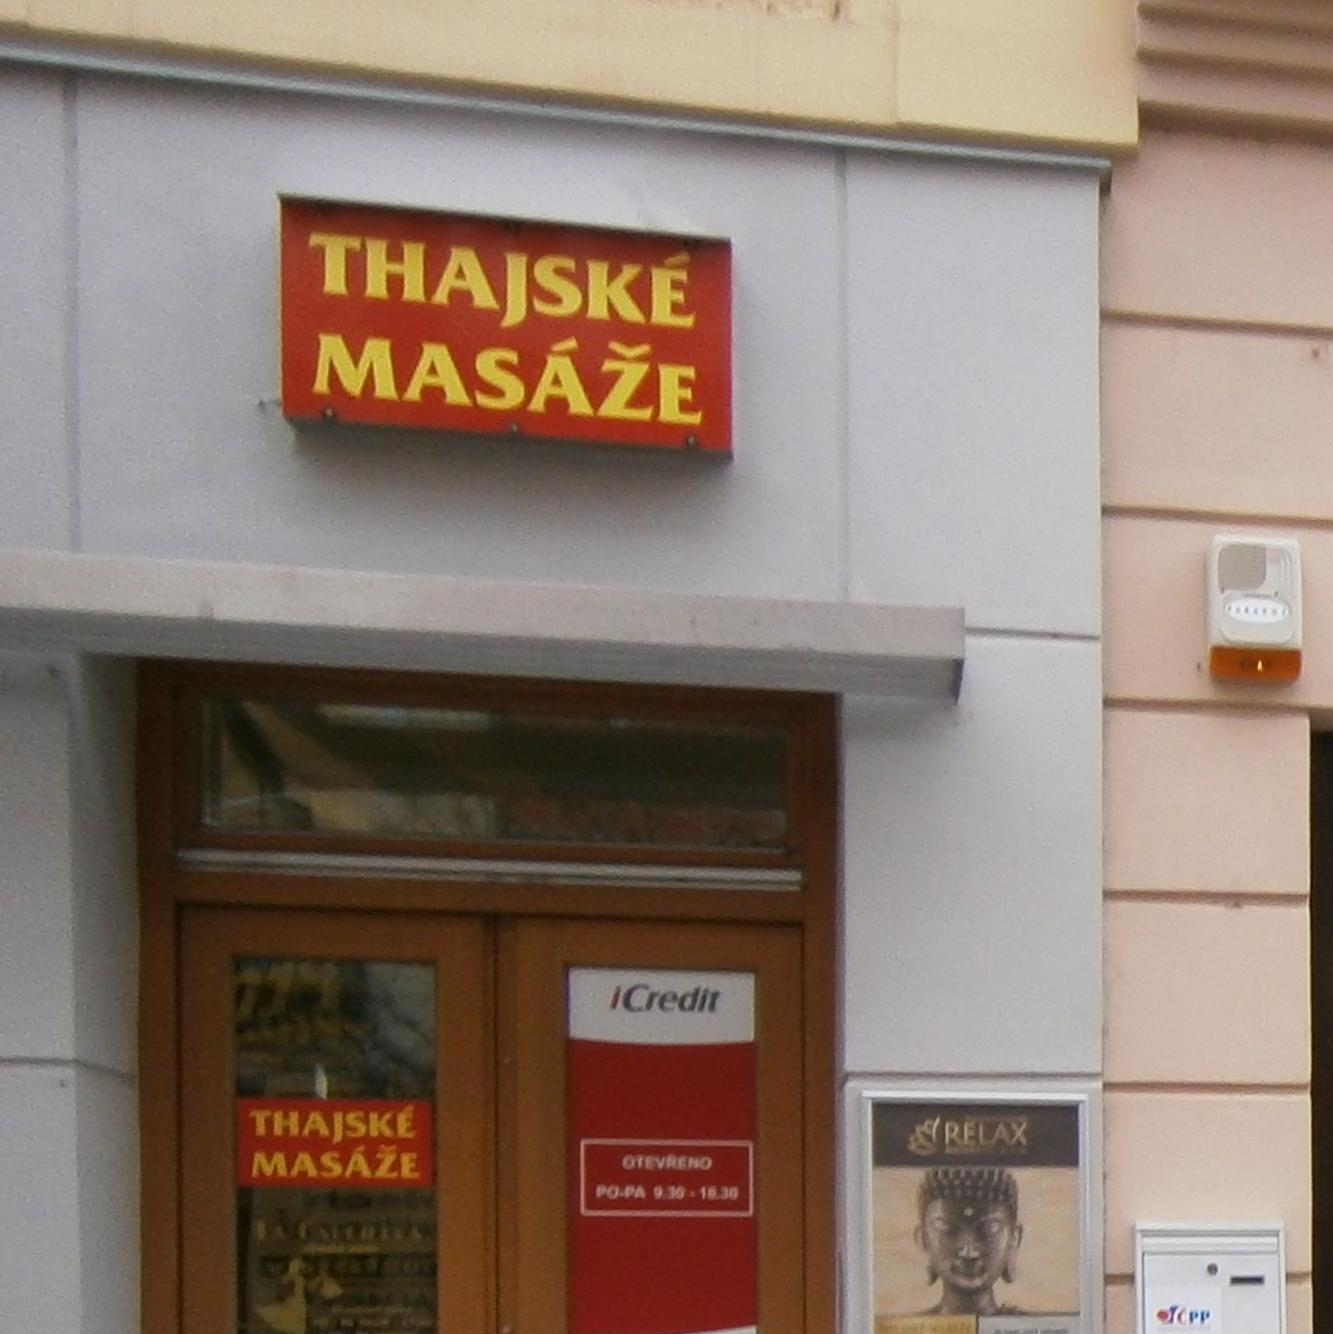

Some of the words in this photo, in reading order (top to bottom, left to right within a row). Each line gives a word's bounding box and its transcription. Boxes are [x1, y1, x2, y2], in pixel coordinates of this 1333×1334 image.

[308, 232, 697, 329] THAJSKÉ
[312, 333, 702, 425] MASÁŽE
[250, 1105, 417, 1144] THAJSKÉ
[944, 1121, 1028, 1146] RELAX
[251, 1145, 420, 1179] MASÁŽE
